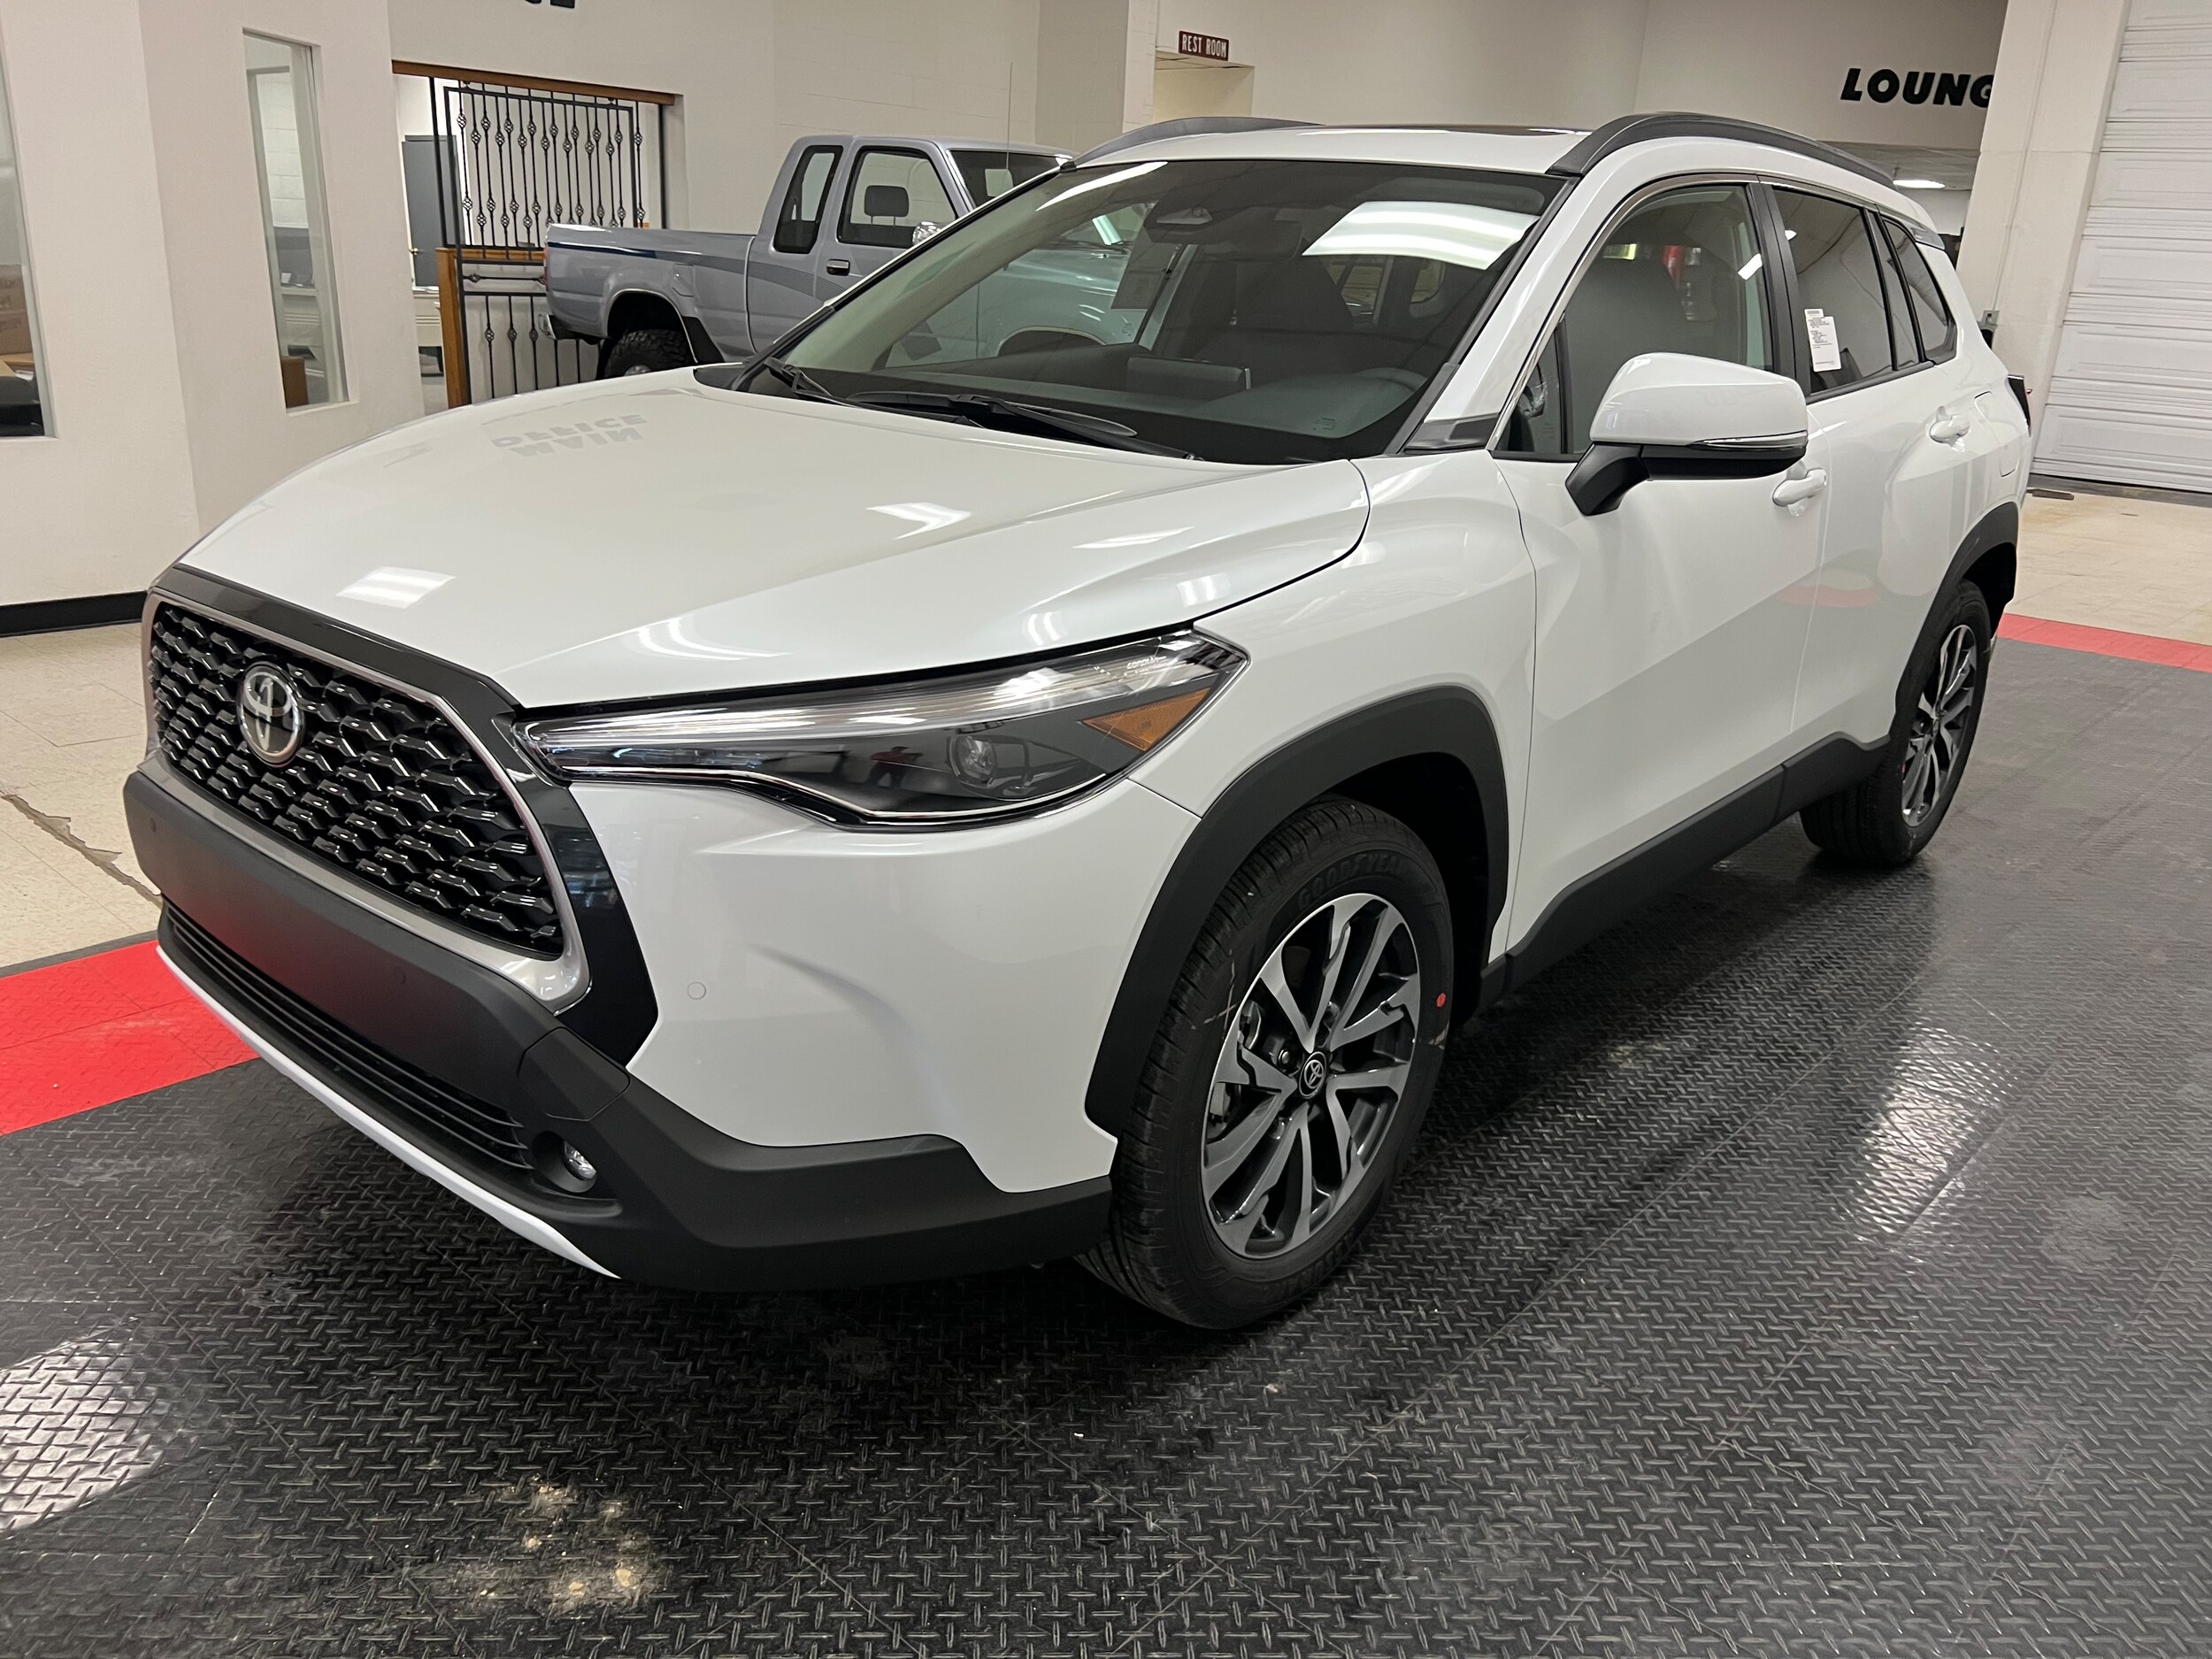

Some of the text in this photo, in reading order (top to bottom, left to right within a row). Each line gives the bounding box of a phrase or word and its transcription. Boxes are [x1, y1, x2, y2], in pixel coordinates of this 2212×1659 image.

[1181, 34, 1227, 58] REST ROOM
[1839, 67, 1994, 108] LOUNG
